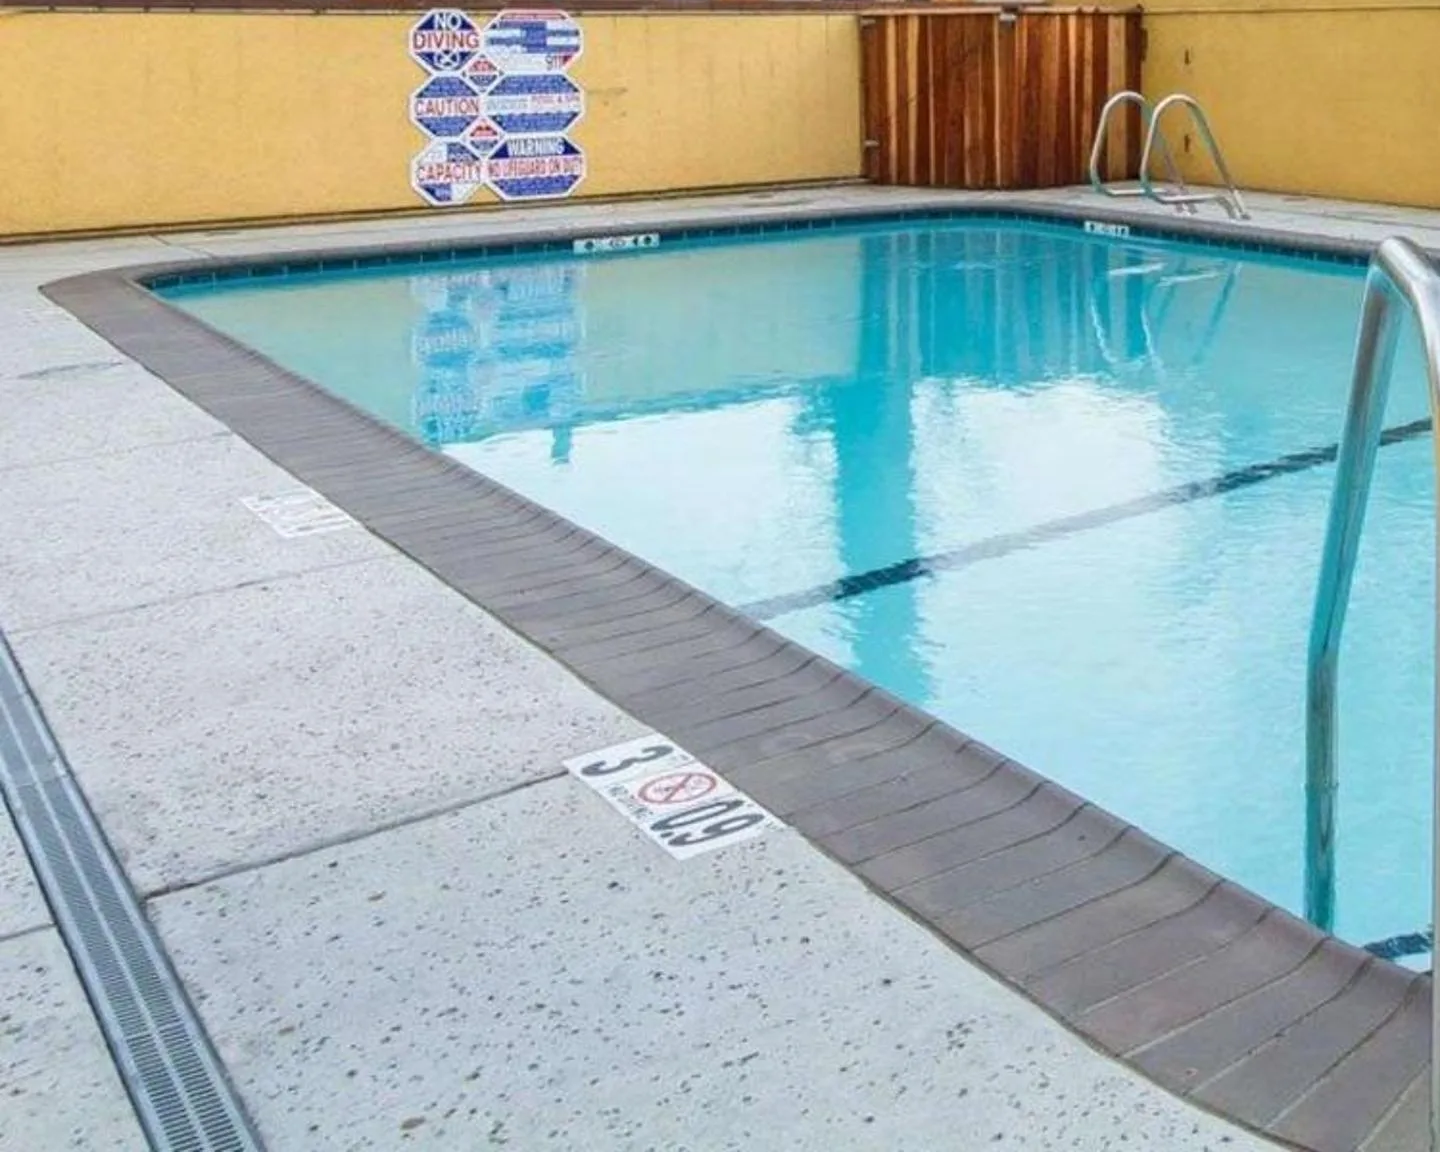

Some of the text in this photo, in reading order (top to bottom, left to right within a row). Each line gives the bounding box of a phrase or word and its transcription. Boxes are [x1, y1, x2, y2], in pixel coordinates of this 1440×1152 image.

[433, 13, 461, 30] NO
[413, 32, 479, 49] DIVING
[415, 98, 479, 116] CAUTION
[416, 162, 481, 182] CAPACITY
